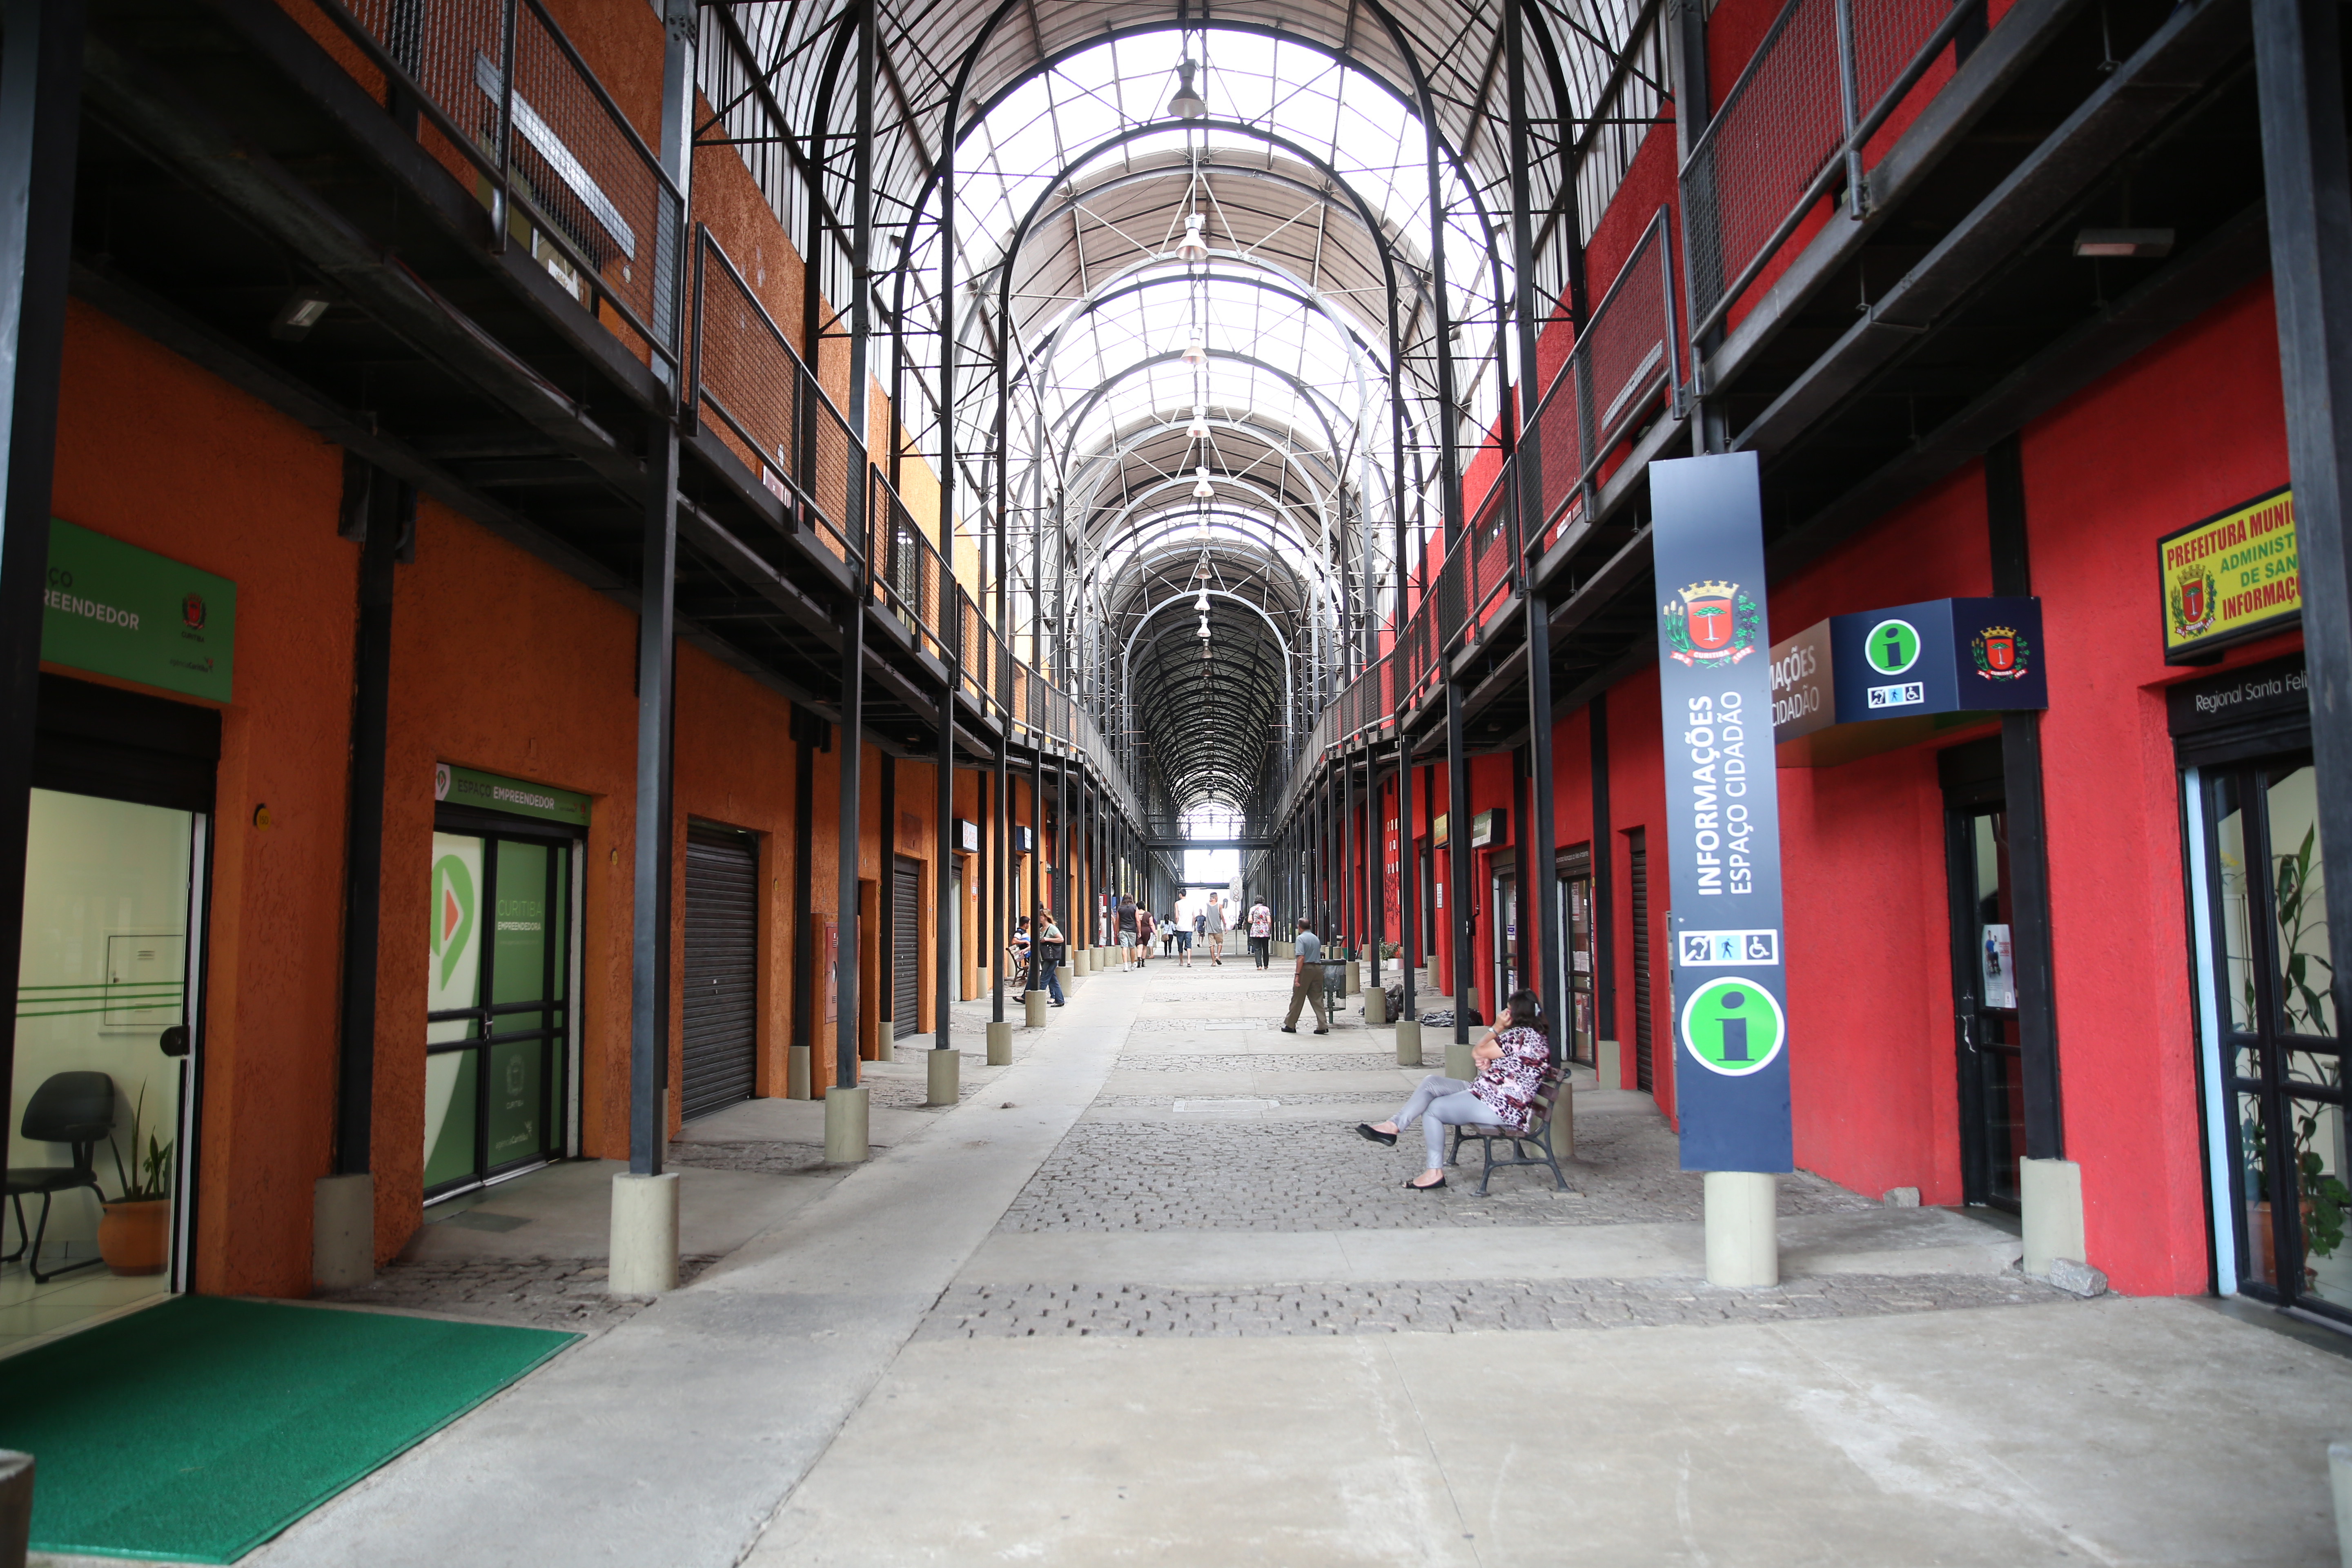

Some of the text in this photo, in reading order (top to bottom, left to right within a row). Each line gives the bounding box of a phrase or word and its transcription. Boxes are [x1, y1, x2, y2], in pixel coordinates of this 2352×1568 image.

[2166, 519, 2247, 570] PREFEITURA
[2240, 553, 2298, 588] DE SAN
[2186, 621, 2203, 630] CURITIBA
[1673, 647, 1751, 664] 29-3 CURITIBA 1693
[1771, 683, 1820, 727] CIDADÃO
[2196, 670, 2307, 713] Regional Santa Feli
[457, 779, 555, 810] ESPAÇO EMPREENDEDOR
[1685, 695, 1723, 895] INFORMAÇÕES
[1717, 690, 1754, 895] ESPAÇO CIDADÃO
[497, 899, 542, 917] CURITIBA
[497, 921, 541, 931] EMPREENDEDORA
